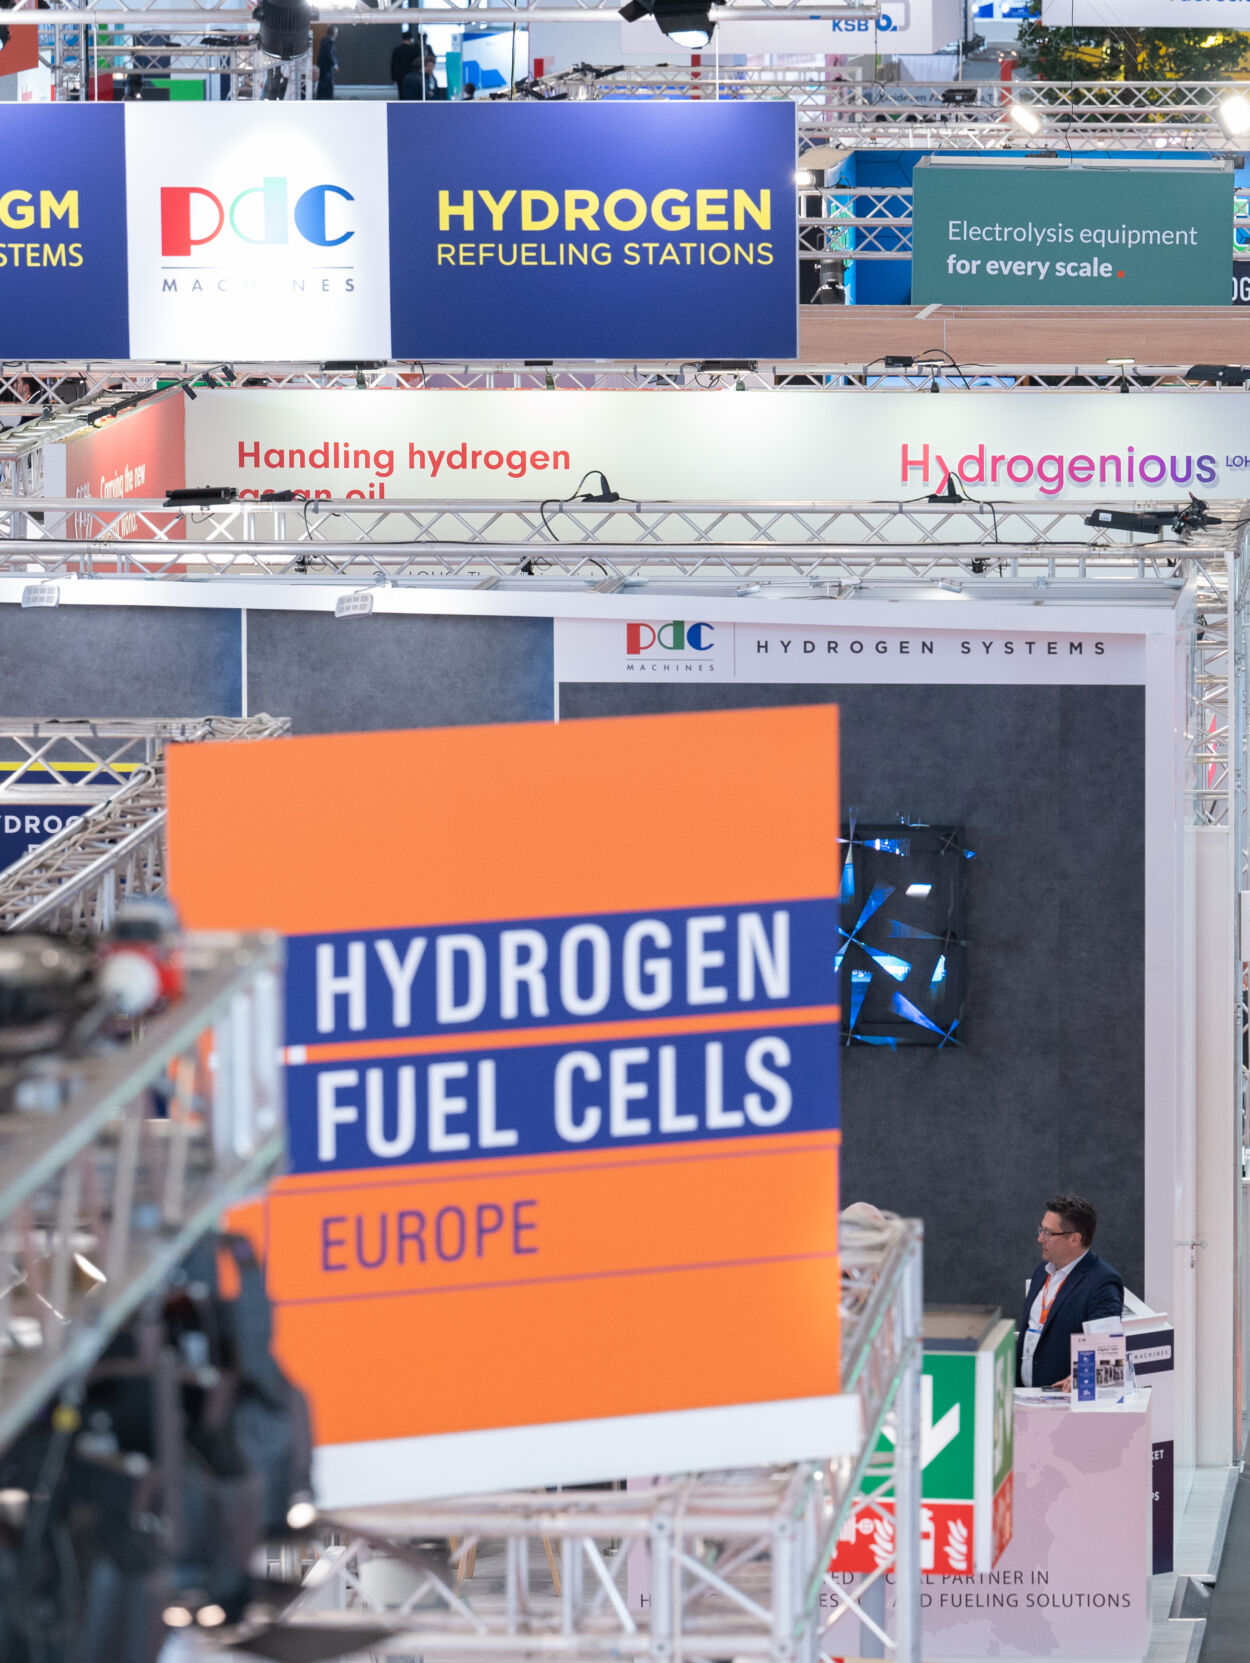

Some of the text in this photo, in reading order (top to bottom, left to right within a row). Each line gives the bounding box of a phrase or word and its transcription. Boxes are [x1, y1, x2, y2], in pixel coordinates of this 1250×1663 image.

[831, 18, 869, 32] KSB
[0, 189, 80, 230] GM
[438, 188, 772, 232] HYDROGEN
[947, 219, 1198, 249] Electrolysis equipment
[0, 242, 84, 268] STEMS
[437, 242, 775, 266] REFUELING STATIONS
[946, 253, 982, 275] for
[985, 258, 1051, 281] every
[162, 278, 355, 293] MACHNES
[238, 441, 570, 478] Handling hydrogen
[901, 443, 1217, 495] Hydrogenious
[756, 640, 934, 655] HYDROGEN
[960, 640, 1106, 656] SYSTEMS
[626, 664, 715, 672] MACHINES
[0, 814, 82, 834] DRO
[314, 909, 792, 1035] HYDROGEN
[316, 1034, 795, 1163] FUEL CELLS
[320, 1199, 541, 1273] EUROPE
[1133, 1349, 1169, 1360] MACHINES
[942, 1570, 1024, 1585] PARTNER
[1031, 1571, 1050, 1585] IN
[940, 1592, 1020, 1609] FUELING
[1026, 1592, 1132, 1609] SOLUTIONS
